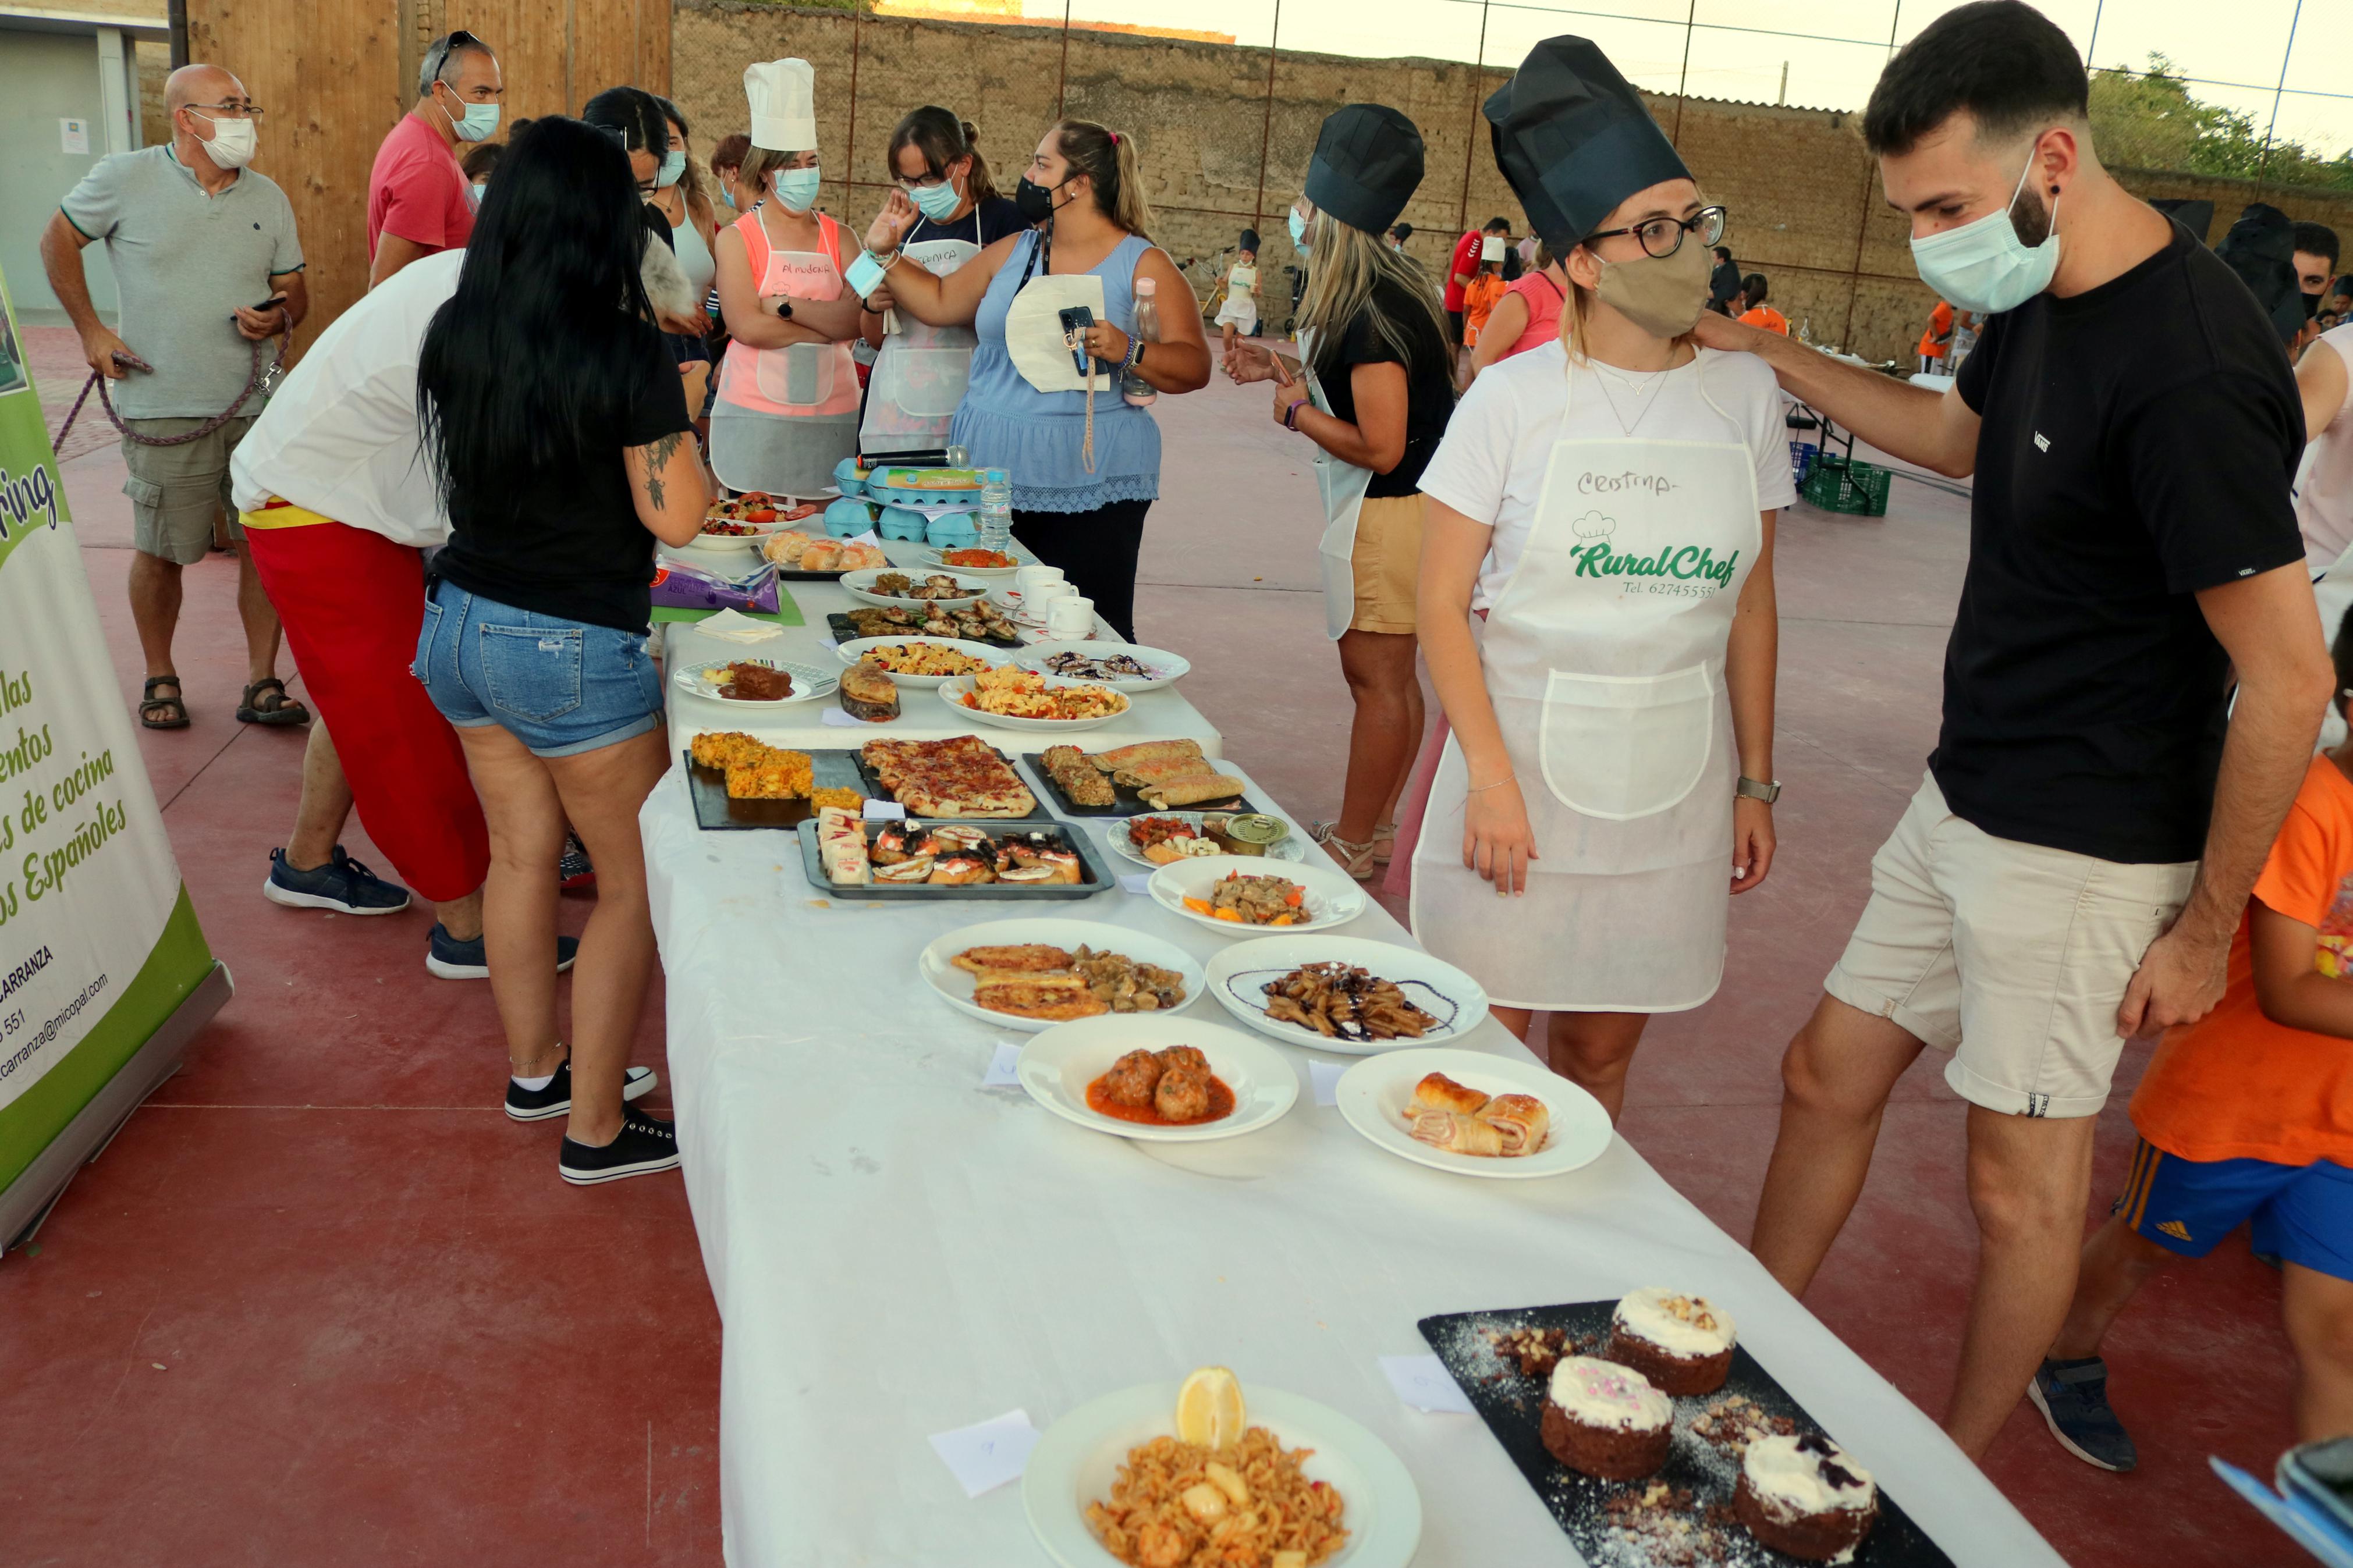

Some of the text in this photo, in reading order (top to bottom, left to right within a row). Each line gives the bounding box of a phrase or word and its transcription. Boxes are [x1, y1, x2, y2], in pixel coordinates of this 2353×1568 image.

[2034, 431, 2050, 453] VANS
[1570, 542, 1739, 589] RuralChef
[668, 585, 686, 595] AZUL
[1623, 582, 1716, 599] Tel. 627455551
[22, 790, 47, 834] de
[53, 748, 113, 812] cocina
[23, 799, 125, 901] Españoles
[4, 1008, 25, 1034] 551
